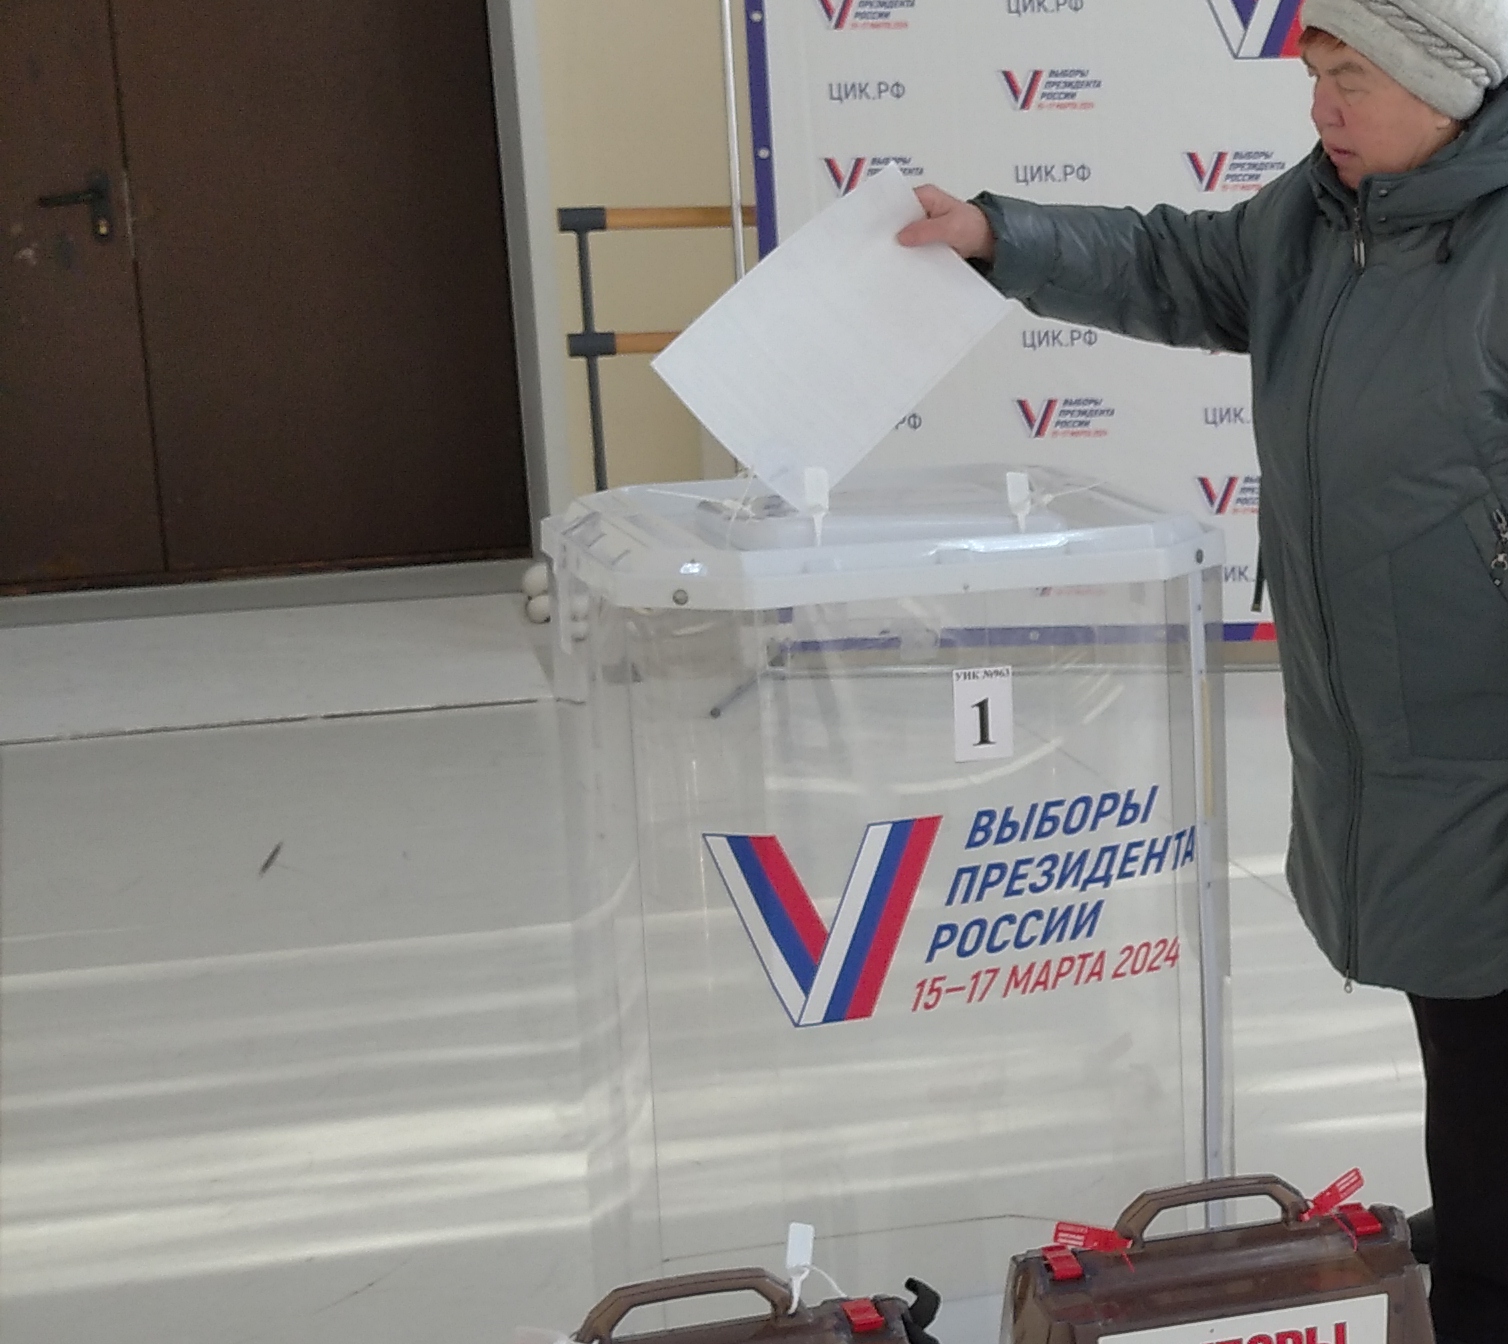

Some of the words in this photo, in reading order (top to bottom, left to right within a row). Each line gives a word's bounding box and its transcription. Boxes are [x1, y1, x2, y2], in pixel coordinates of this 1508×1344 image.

[828, 81, 906, 103] ЦИК.РФ
[1014, 163, 1092, 187] ЦИК.РФ
[1021, 328, 1098, 352] ЦИК.РФ
[1204, 407, 1251, 429] ЦИК.
[971, 697, 997, 747] 1
[965, 785, 1159, 850] ВЫБОРЫ
[944, 825, 1196, 907] ПРЕЗИДЕНТА
[924, 899, 1105, 964] РОССИИ
[1002, 950, 1106, 999] МАРТА
[1111, 935, 1181, 980] 2024
